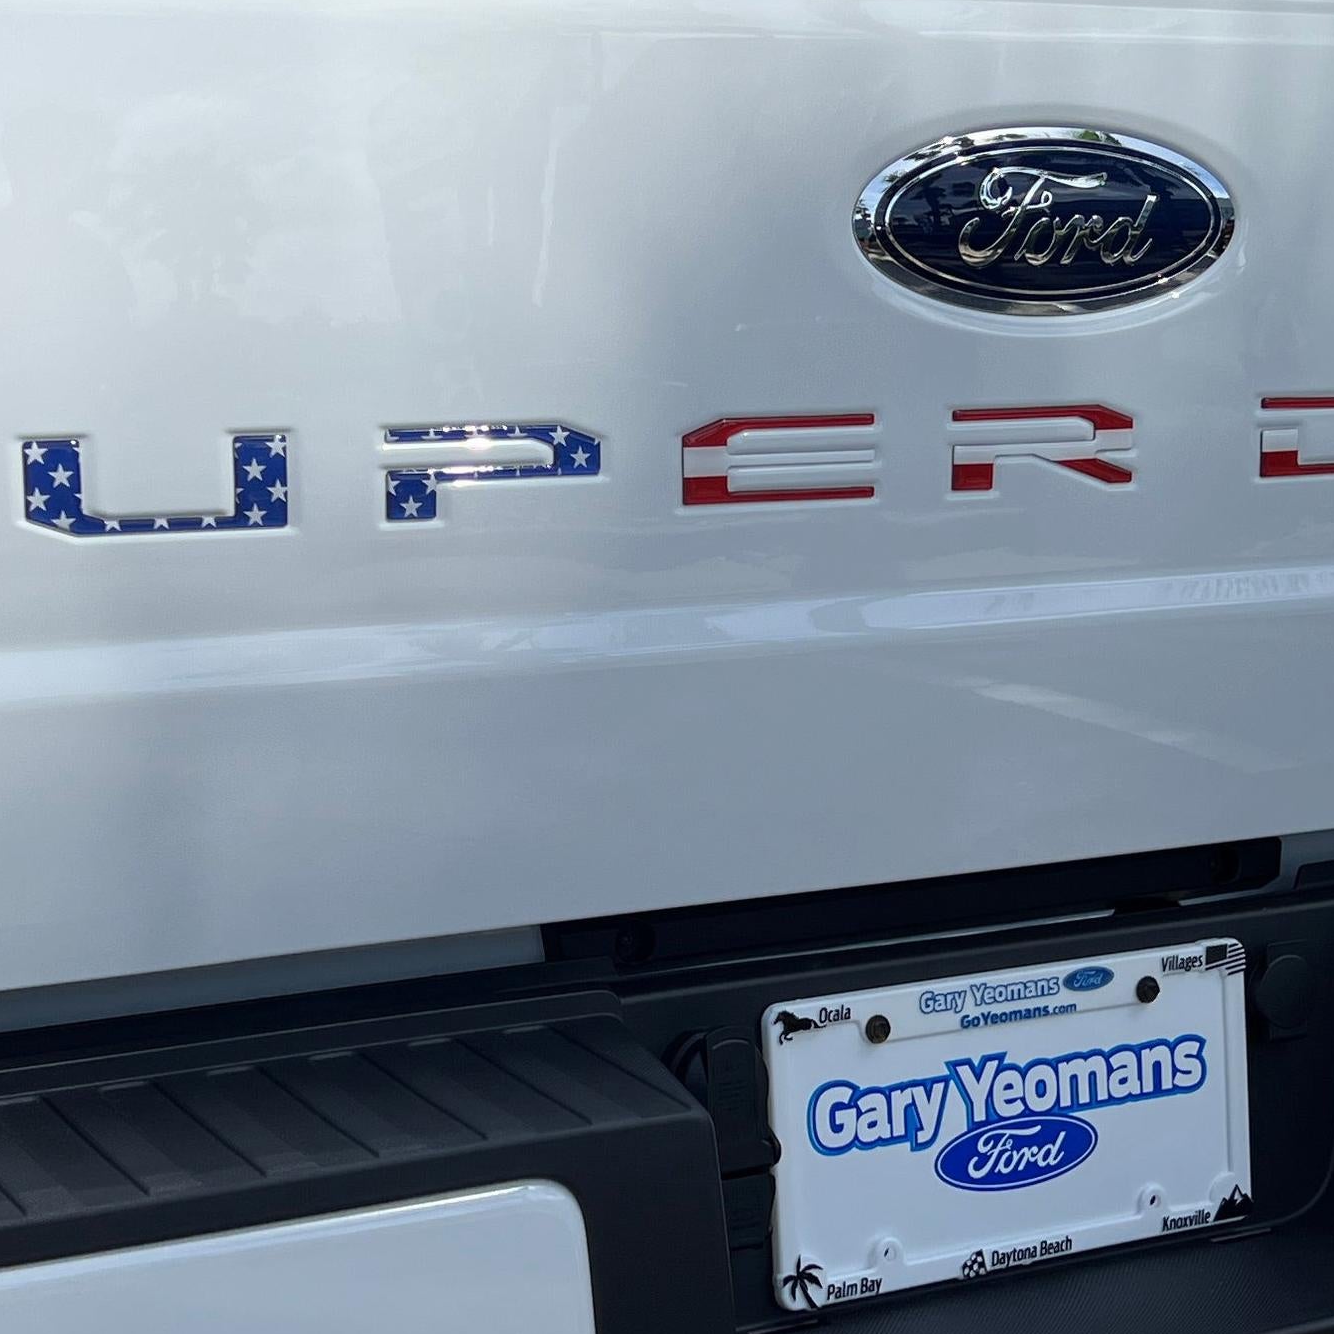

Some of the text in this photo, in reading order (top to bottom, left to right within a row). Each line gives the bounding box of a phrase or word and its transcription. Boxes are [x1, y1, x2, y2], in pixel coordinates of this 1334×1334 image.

[958, 166, 1160, 267] Ford
[1160, 953, 1204, 973] Villages
[919, 970, 1106, 1015] Gary Yeomans Ford
[818, 1004, 851, 1024] Ocala
[959, 1002, 1077, 1028] GoYeomans.com
[809, 1035, 1206, 1154] Gary Yeomans
[967, 1125, 1064, 1180] Ford
[1162, 1210, 1212, 1233] Knoxville
[991, 1236, 1073, 1268] Daytona Beach
[827, 1276, 883, 1301] Palm Bay
